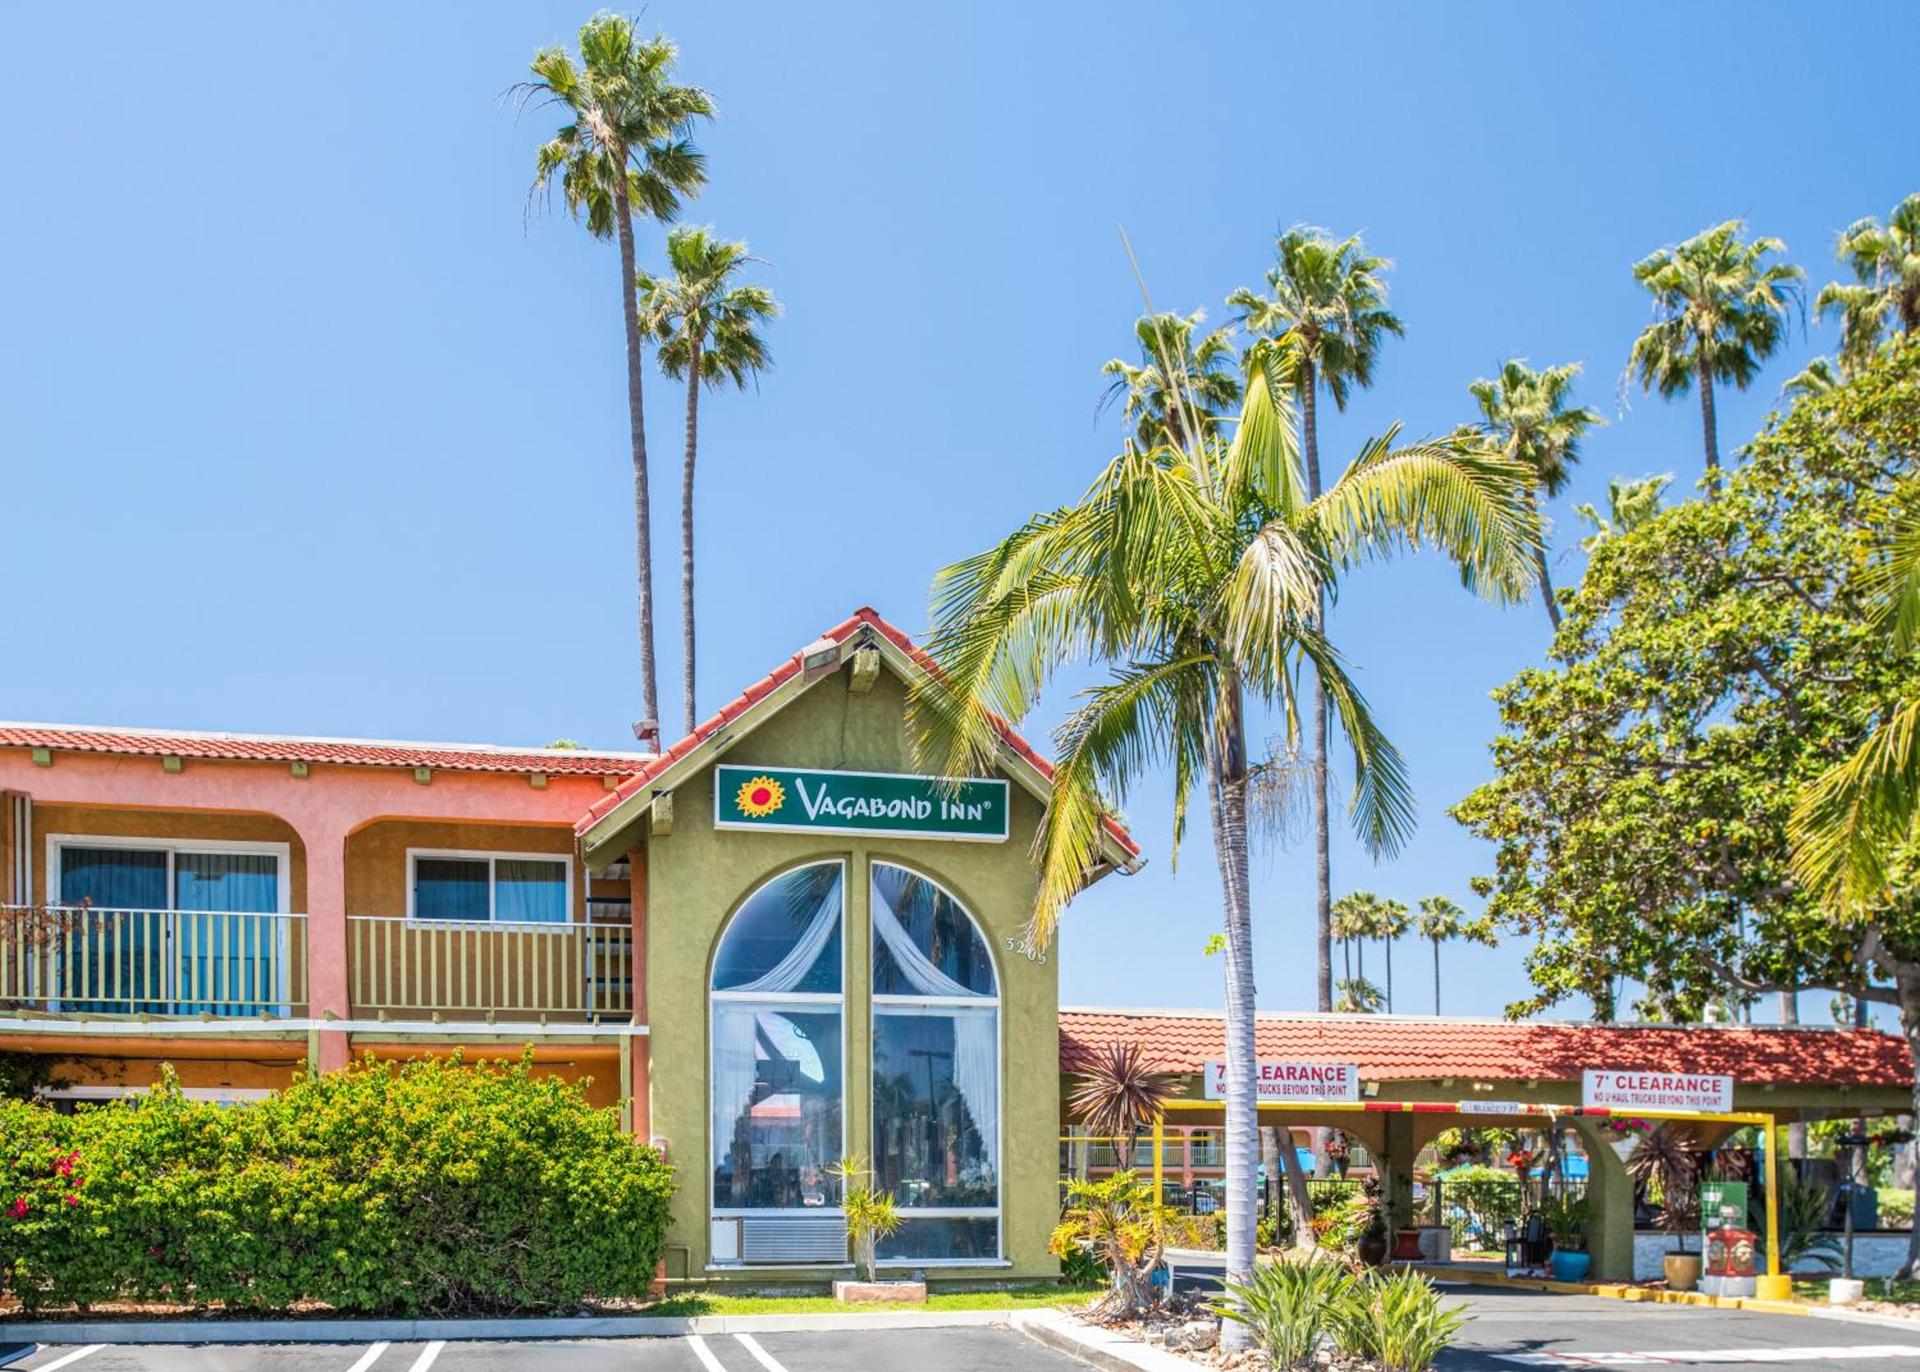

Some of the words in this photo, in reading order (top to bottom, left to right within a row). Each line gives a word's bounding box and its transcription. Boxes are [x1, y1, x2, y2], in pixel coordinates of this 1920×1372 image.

[795, 777, 931, 821] VAGABOND
[1256, 1065, 1346, 1081] EARANCE
[1282, 1084, 1309, 1095] BEYOND
[1311, 1085, 1326, 1096] THIS
[1327, 1085, 1347, 1096] POINT
[1615, 1075, 1722, 1092] CLEARANCE
[1594, 1092, 1603, 1103] NO
[1631, 1093, 1656, 1104] TRUCKS
[1658, 1094, 1683, 1105] BEYOND
[1686, 1095, 1700, 1106] THIS
[1702, 1095, 1722, 1107] POINT
